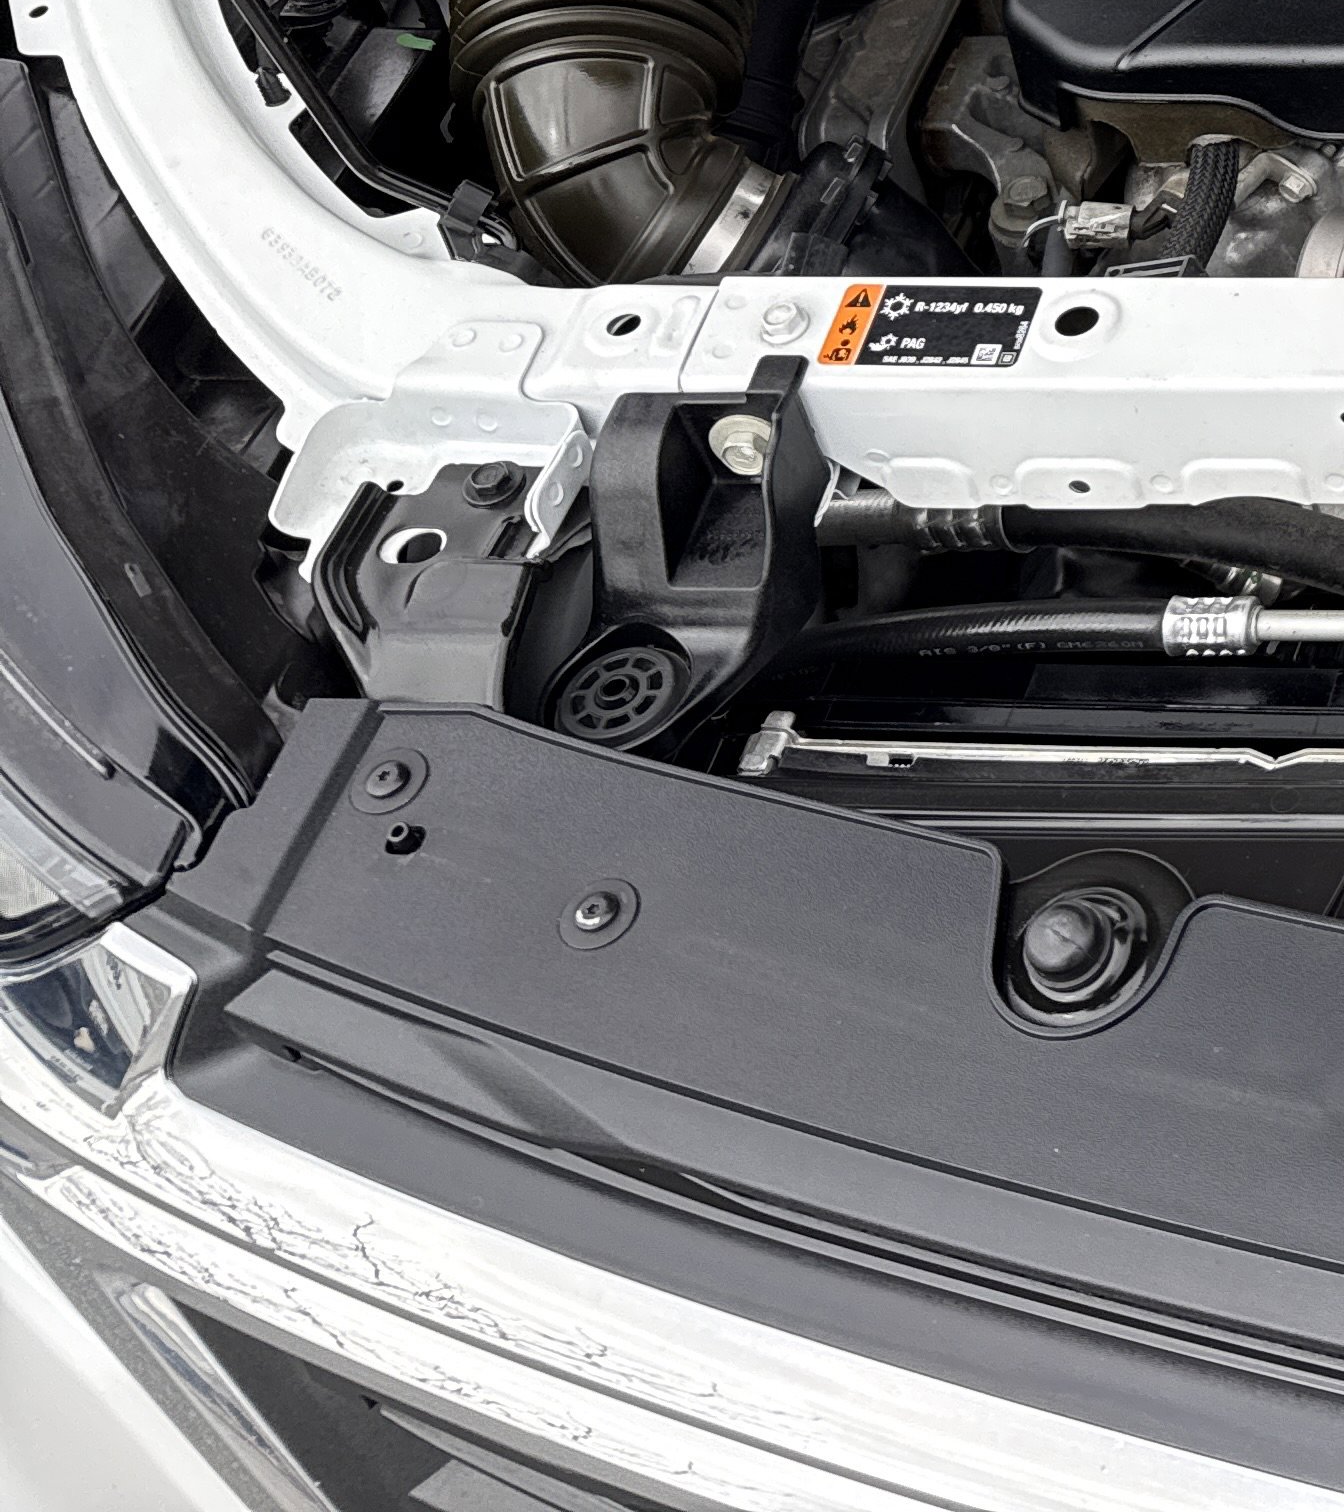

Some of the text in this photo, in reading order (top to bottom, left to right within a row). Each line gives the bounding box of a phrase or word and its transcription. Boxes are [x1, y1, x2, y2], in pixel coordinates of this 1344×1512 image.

[913, 301, 1025, 316] R-1234yf 0.450 kg
[899, 337, 926, 350] PAG
